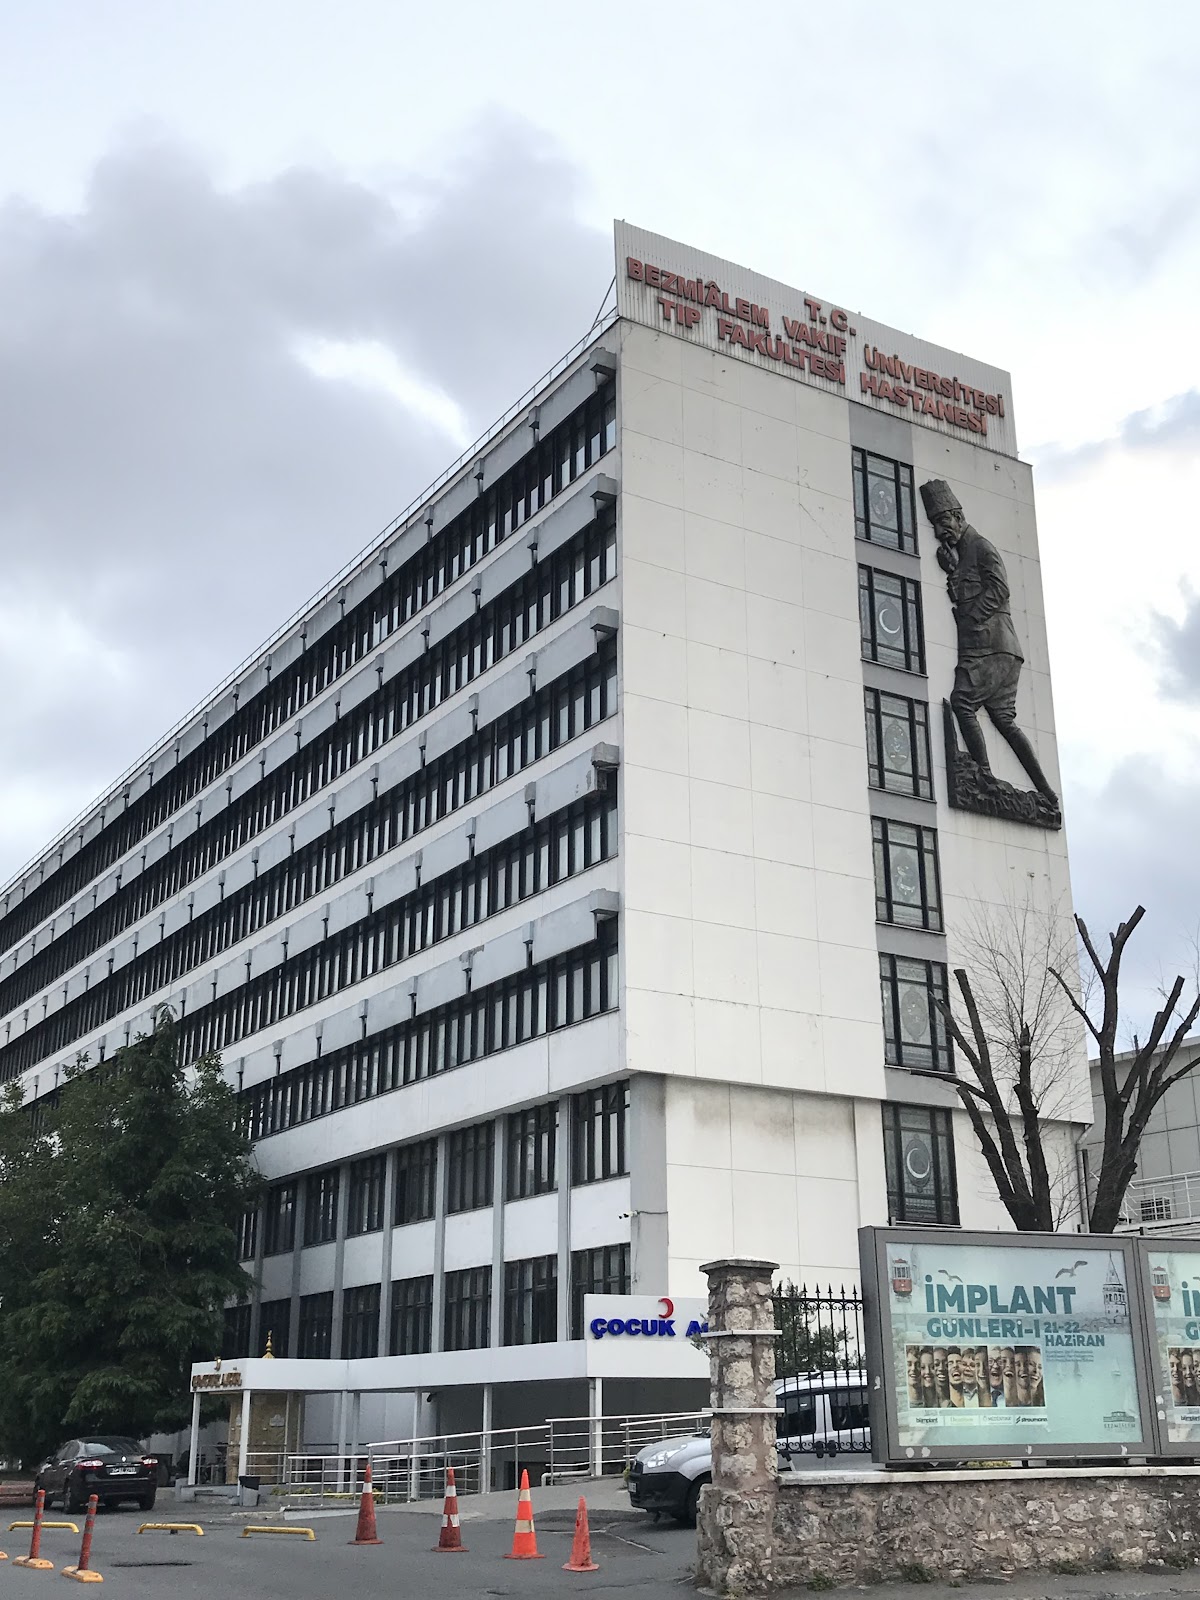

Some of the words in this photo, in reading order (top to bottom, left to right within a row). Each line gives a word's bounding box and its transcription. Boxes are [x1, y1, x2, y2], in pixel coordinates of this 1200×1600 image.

[804, 299, 856, 336] T.C.
[626, 256, 769, 329] BEZMİÂLEM
[782, 316, 847, 357] VAKIF
[864, 343, 1005, 417] ÜNİVERSİTESİ
[657, 297, 701, 328] TIP
[718, 317, 846, 385] FAKÜLTESİ
[860, 372, 988, 436] HASTANESİ
[924, 1274, 1076, 1314] İMPLANT
[590, 1318, 676, 1339] ÇOCUK
[1043, 1321, 1080, 1333] 21-22
[1045, 1334, 1105, 1346] HAZİRAN
